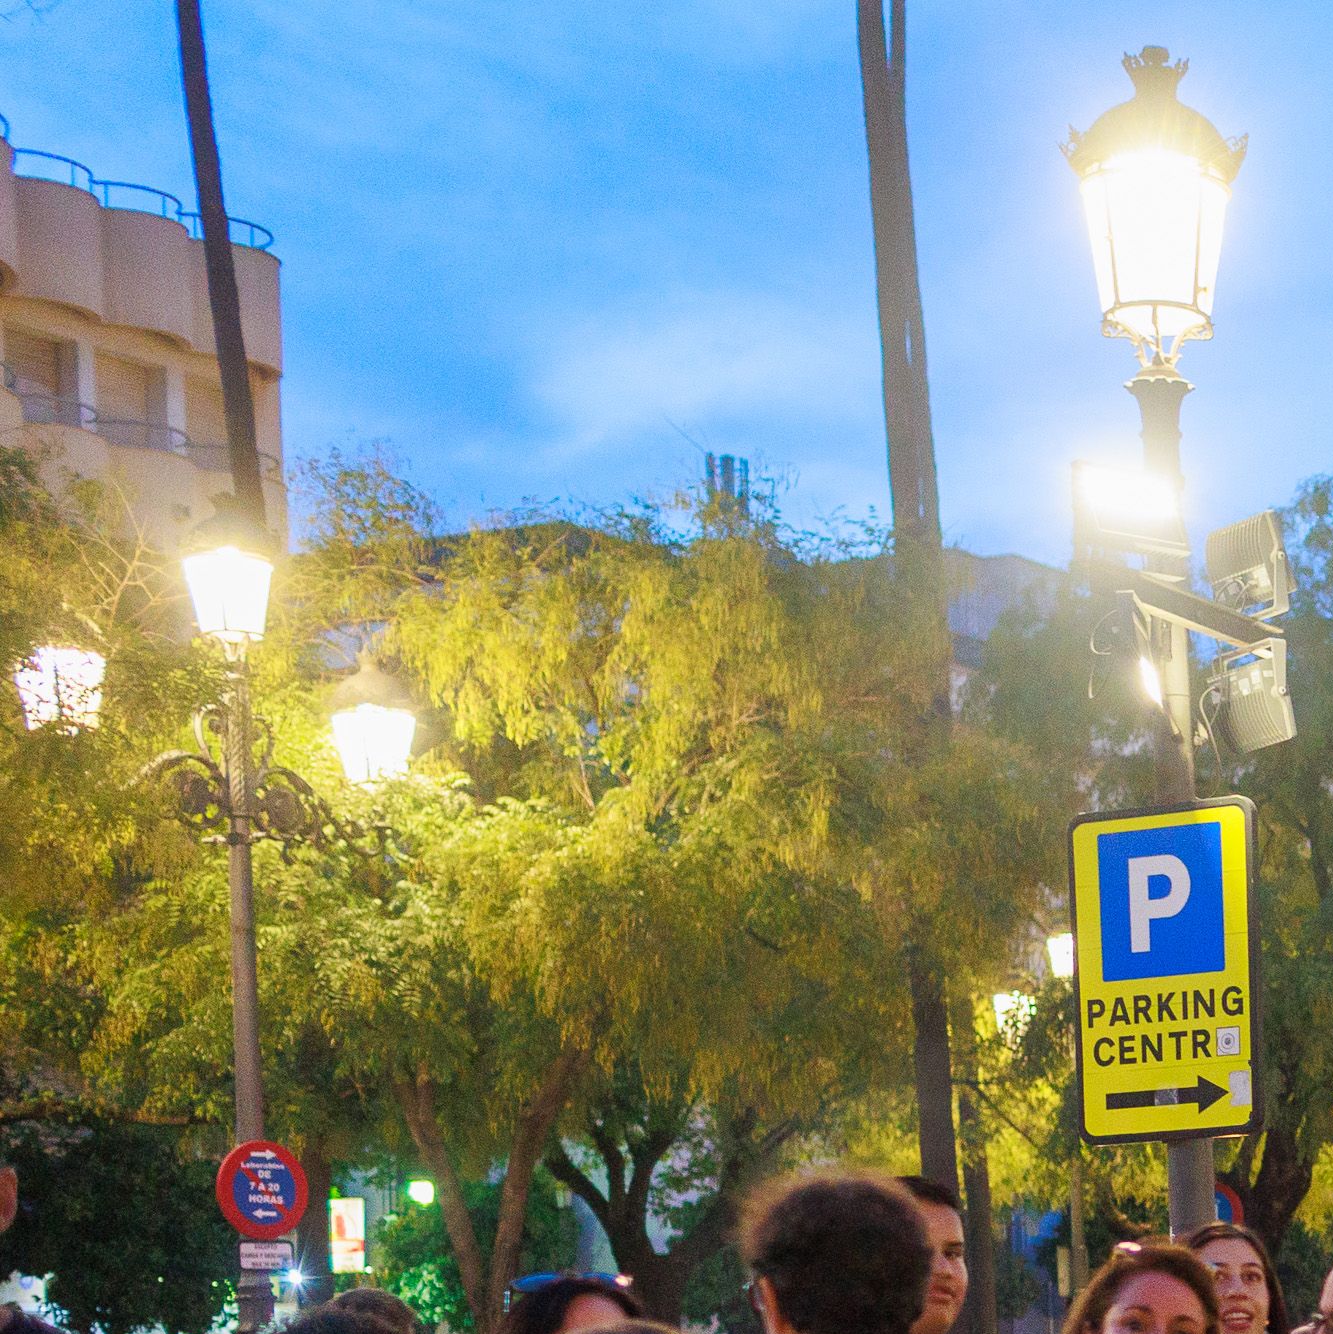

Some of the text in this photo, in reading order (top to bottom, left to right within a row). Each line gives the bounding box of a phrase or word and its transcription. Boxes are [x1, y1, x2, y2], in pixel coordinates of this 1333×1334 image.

[1127, 853, 1192, 954] P
[1086, 985, 1245, 1029] PARKING
[1093, 1028, 1213, 1067] CENTR
[248, 1194, 284, 1205] HORAS
[249, 1181, 280, 1192] 7 A 20
